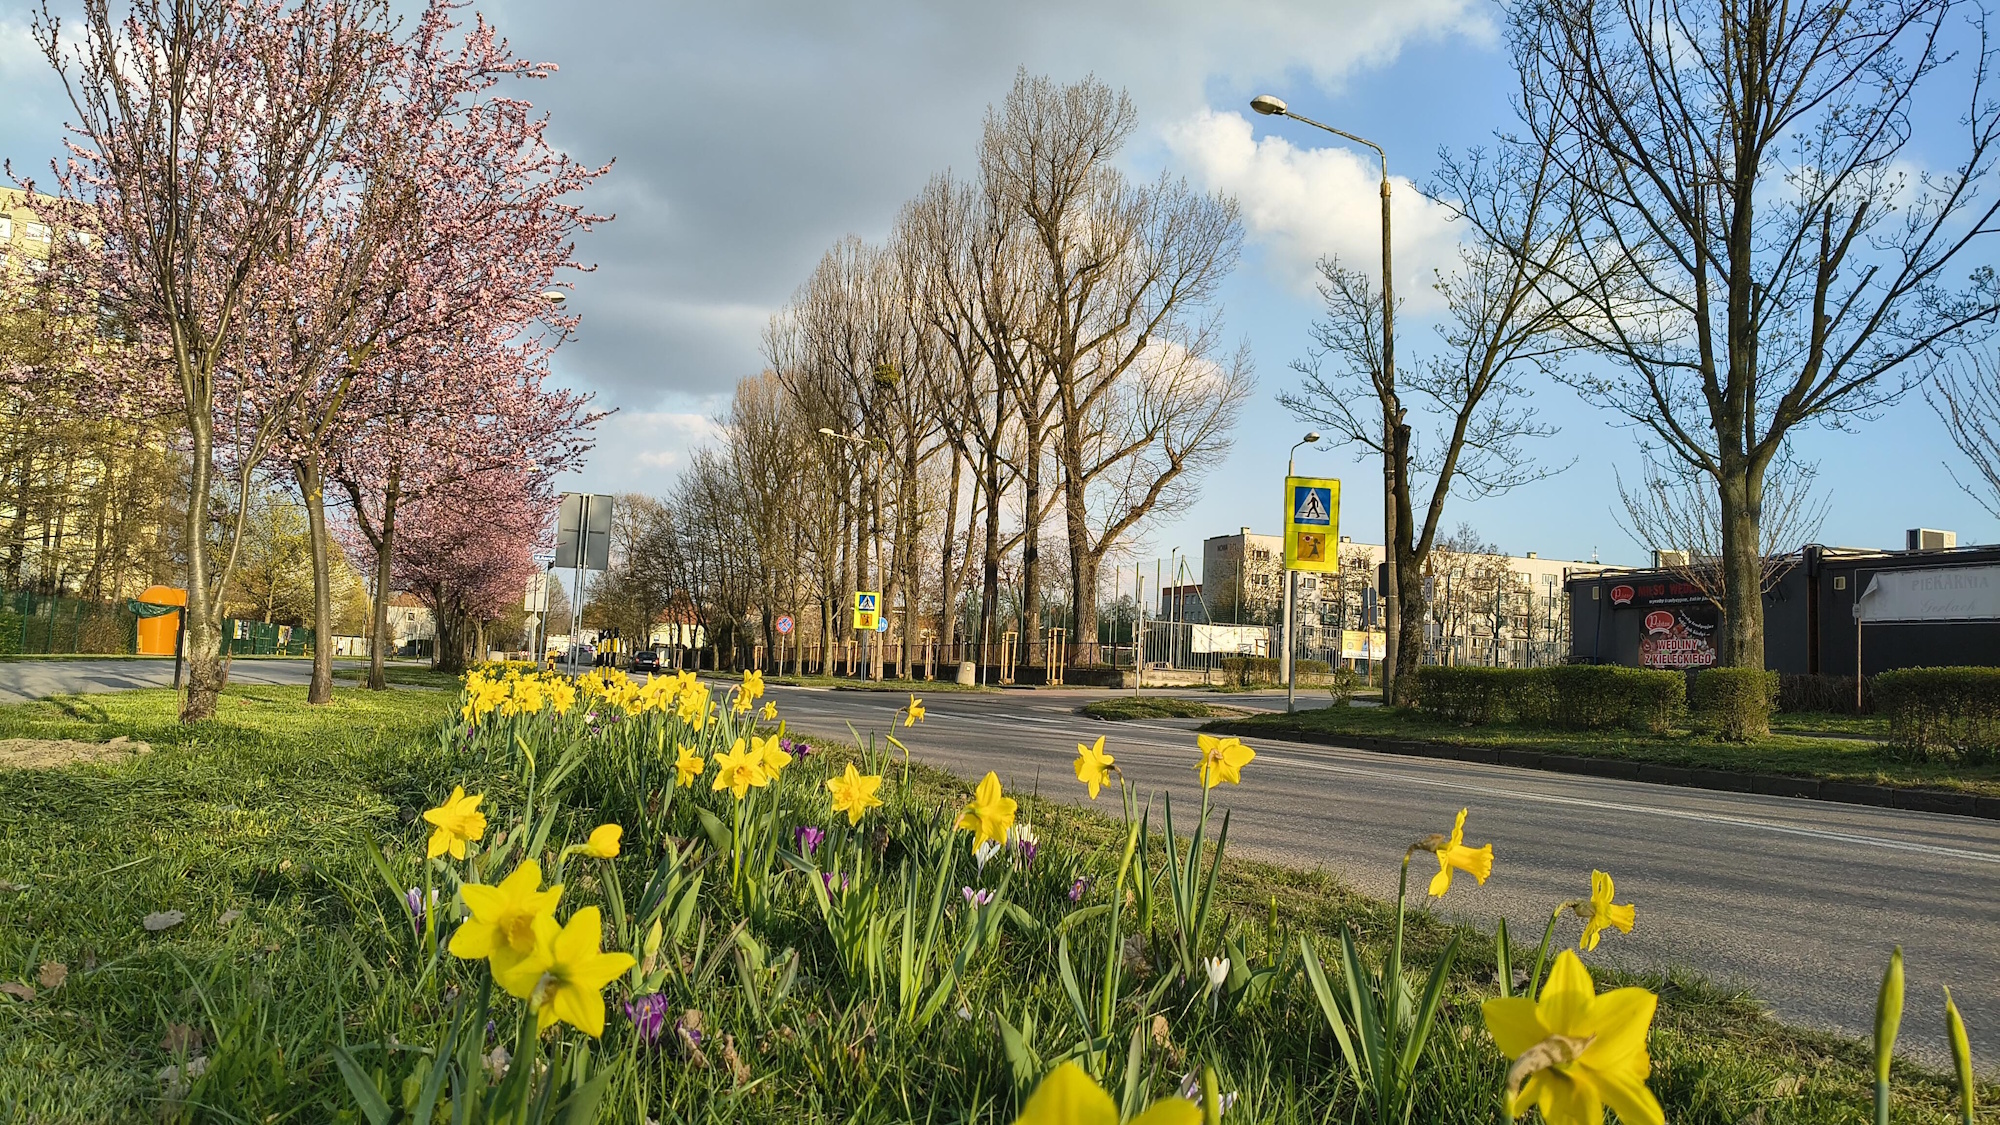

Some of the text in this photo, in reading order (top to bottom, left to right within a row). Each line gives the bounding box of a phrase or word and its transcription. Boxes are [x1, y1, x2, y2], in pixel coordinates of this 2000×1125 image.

[1912, 574, 1989, 591] PIEKARNIA
[1920, 599, 1976, 613] Gerlach
[1657, 639, 1699, 652] WĘDLINY
[1644, 653, 1713, 666] Z KIELECKIEGO
